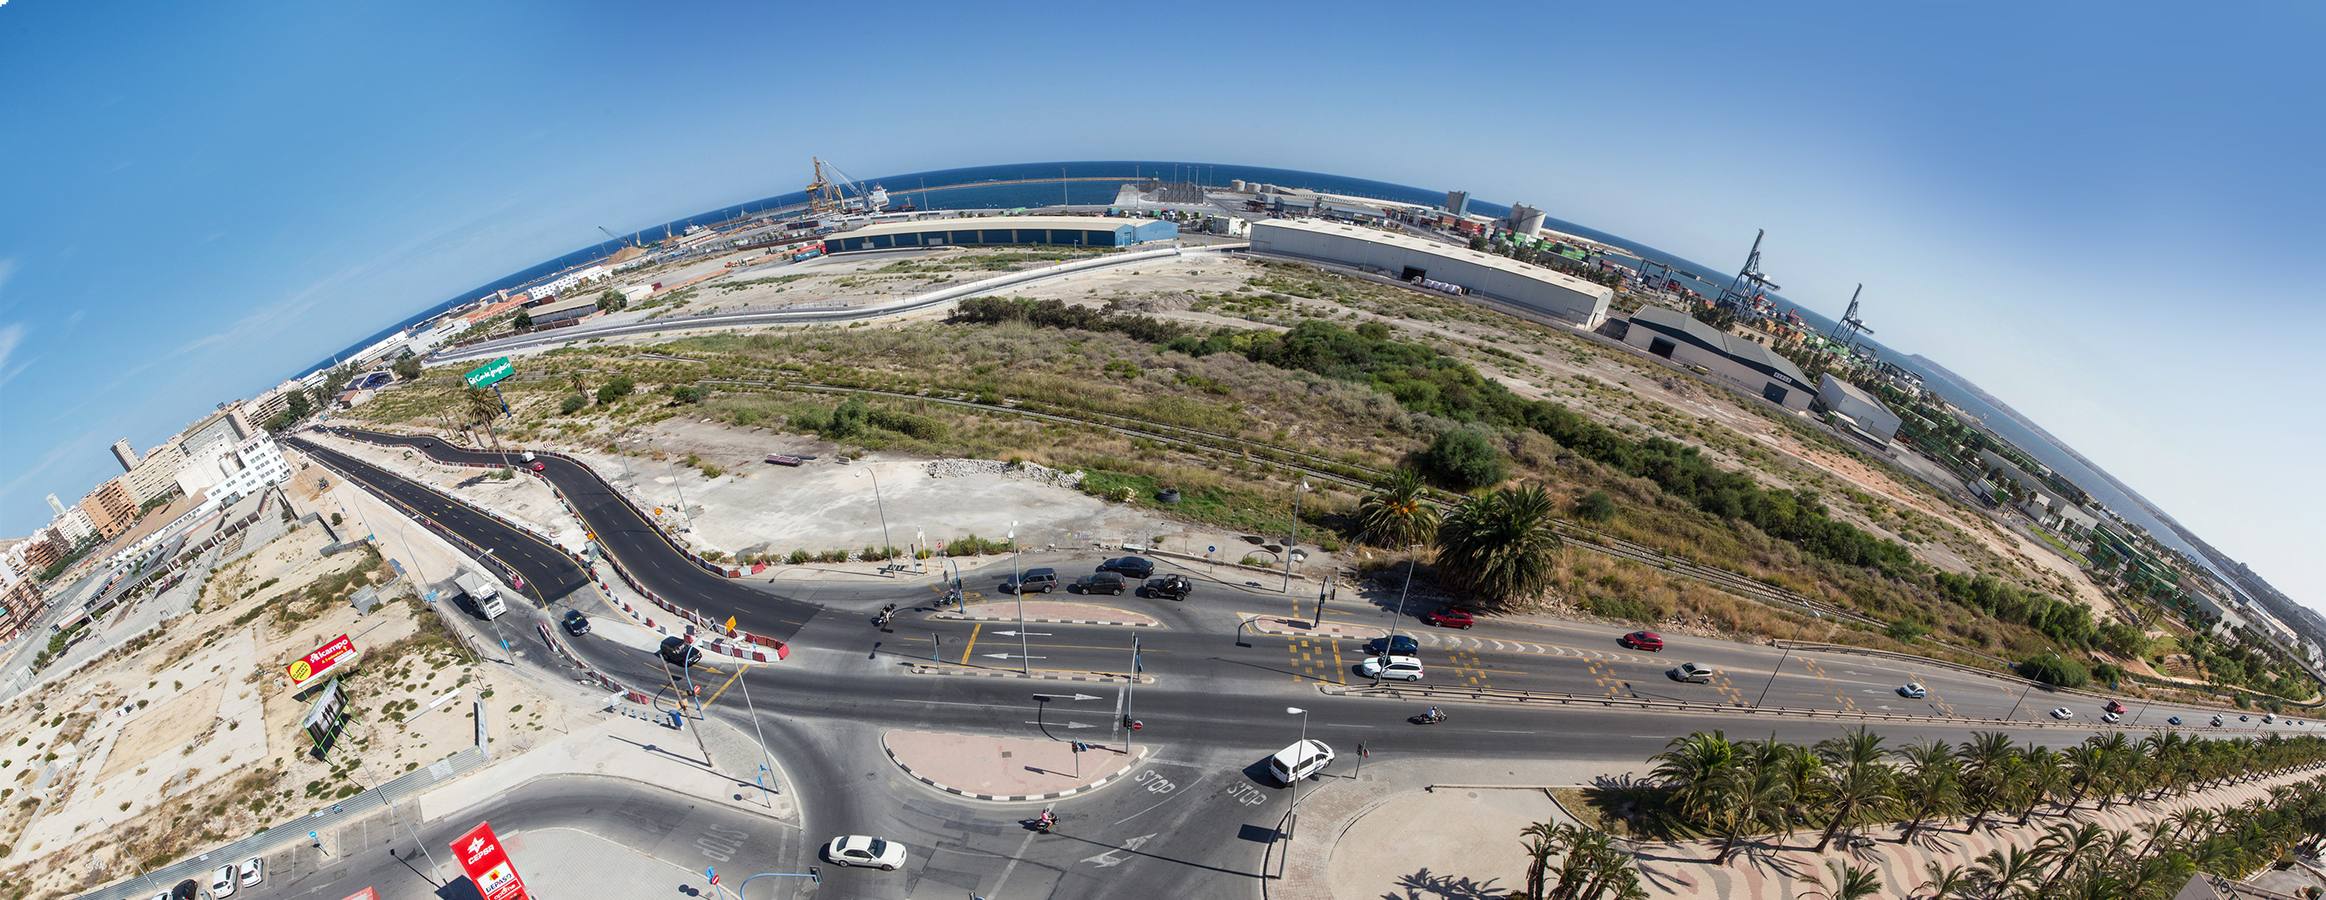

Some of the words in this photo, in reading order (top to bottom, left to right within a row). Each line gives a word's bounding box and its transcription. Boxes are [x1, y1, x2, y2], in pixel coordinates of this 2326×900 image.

[310, 639, 348, 663] Alcampo
[1134, 769, 1176, 795] STOP
[1226, 780, 1268, 807] STOP
[467, 844, 495, 865] CEPSA
[692, 823, 749, 862] STOP
